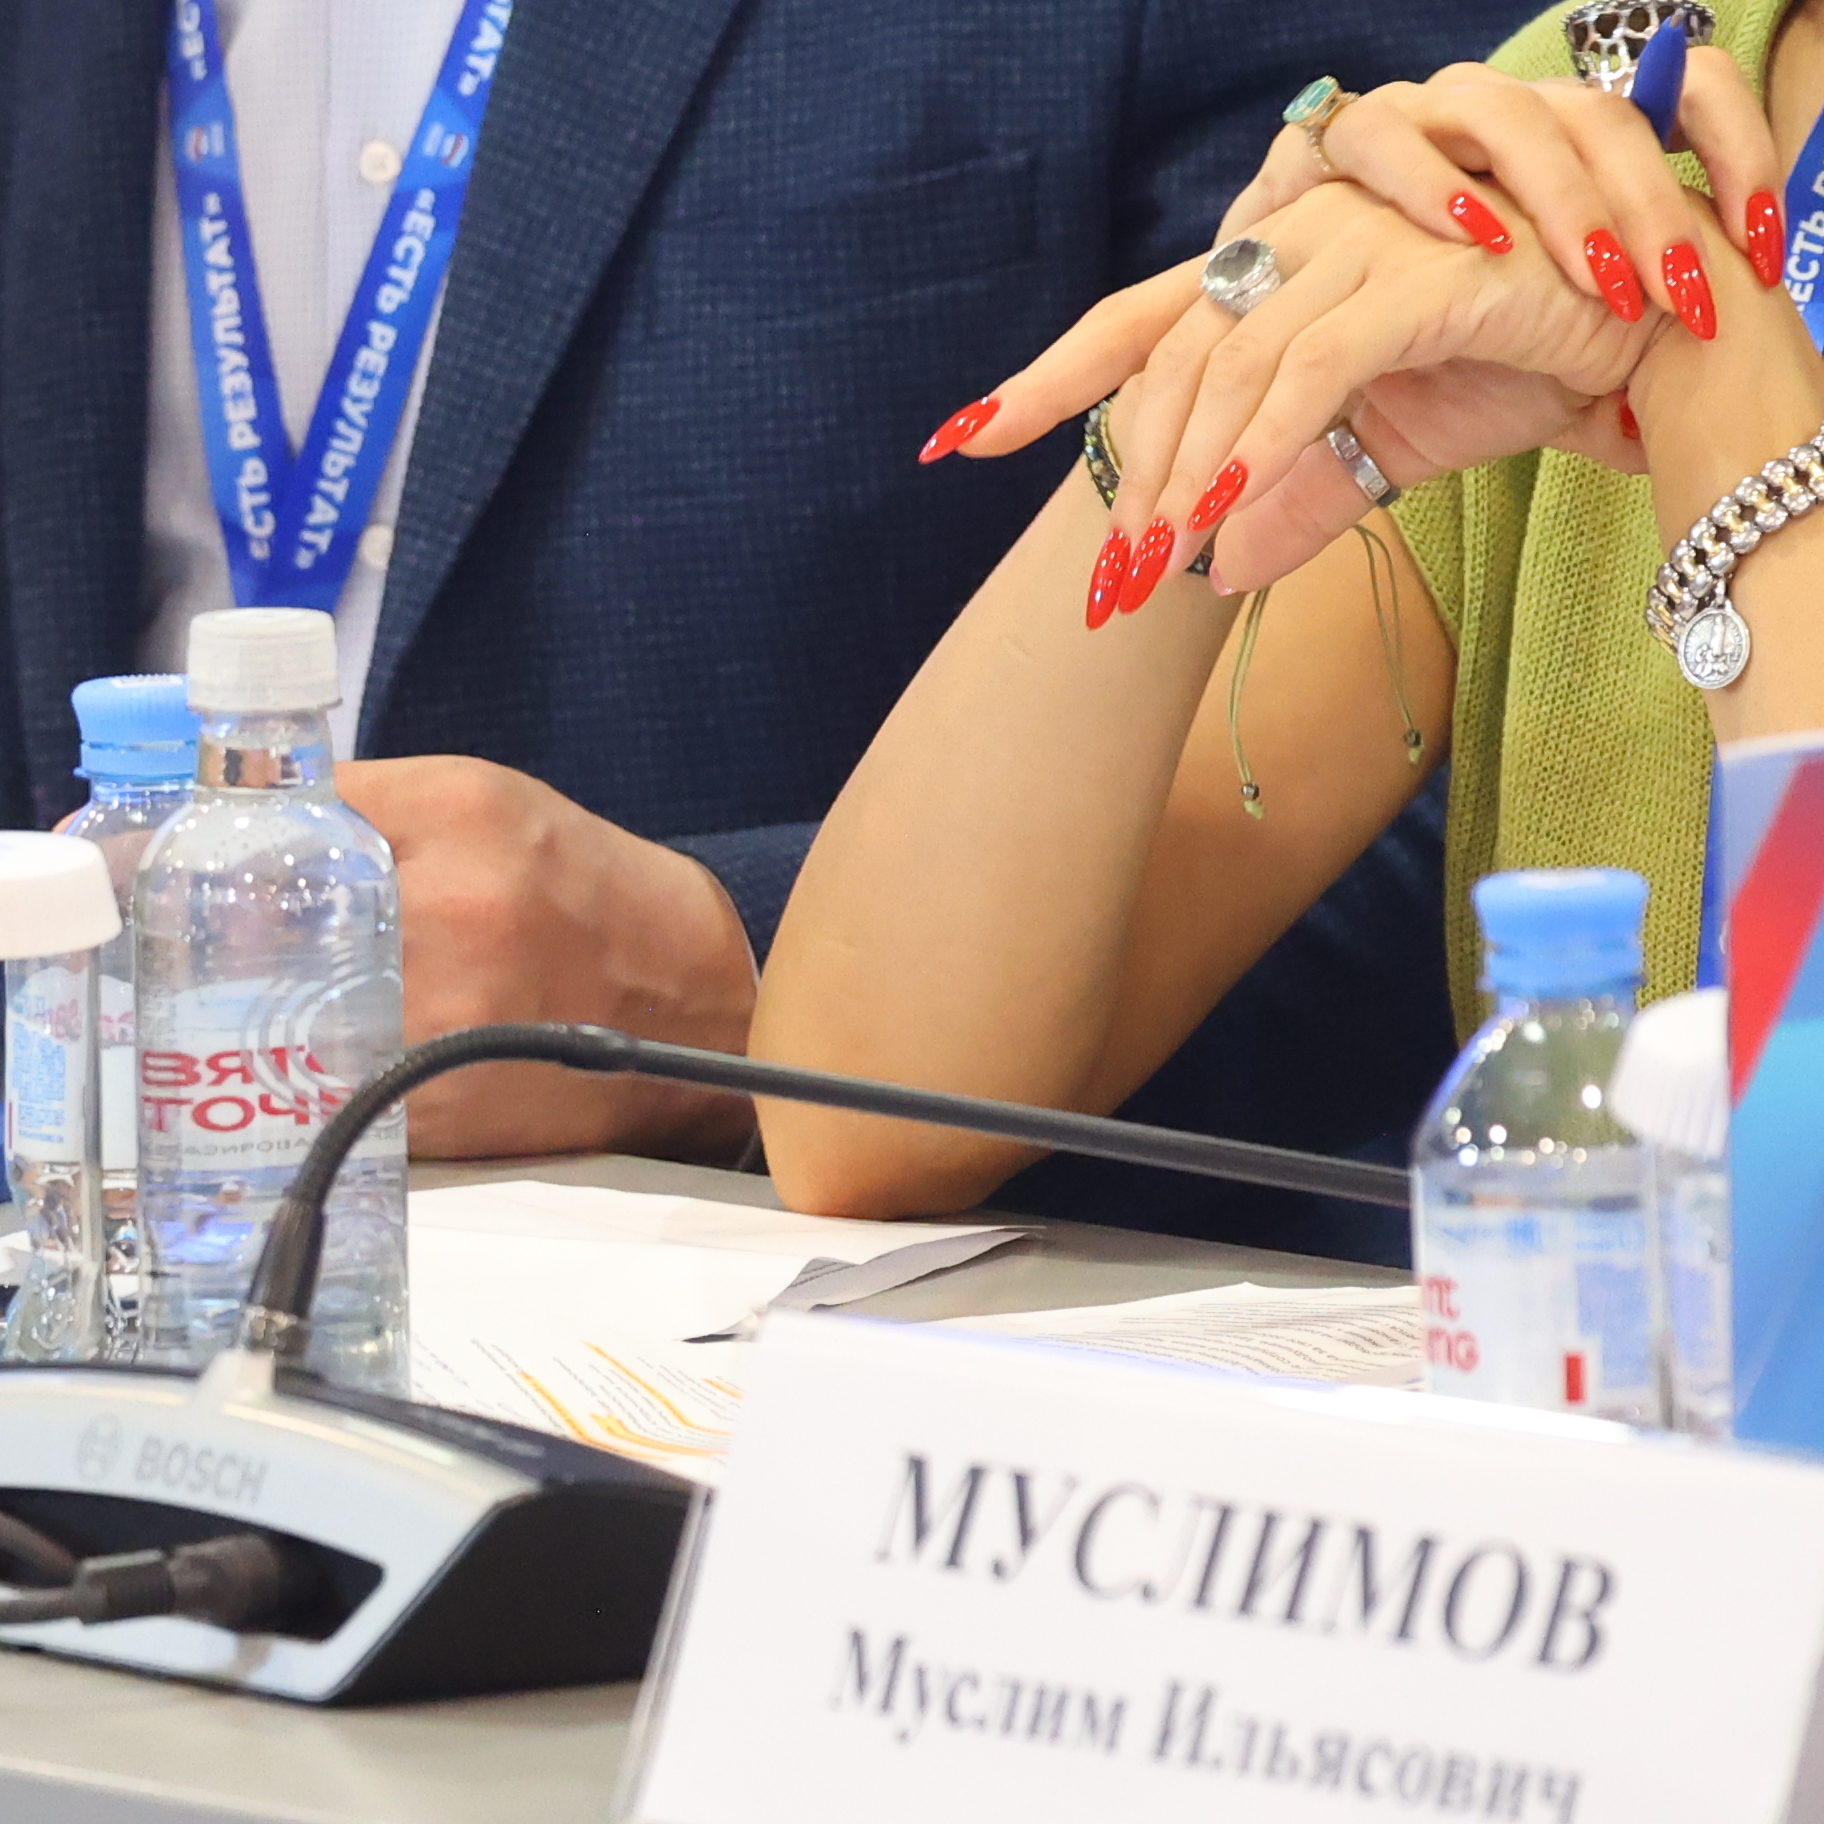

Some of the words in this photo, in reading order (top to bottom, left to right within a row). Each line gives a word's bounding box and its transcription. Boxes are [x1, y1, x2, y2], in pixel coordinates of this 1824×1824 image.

[135, 1434, 270, 1505] BOSCH
[873, 1449, 1619, 1674] МУСЛИМОВ
[829, 1624, 1127, 1754] Муслим
[1151, 1678, 1586, 1824] Ильясович
